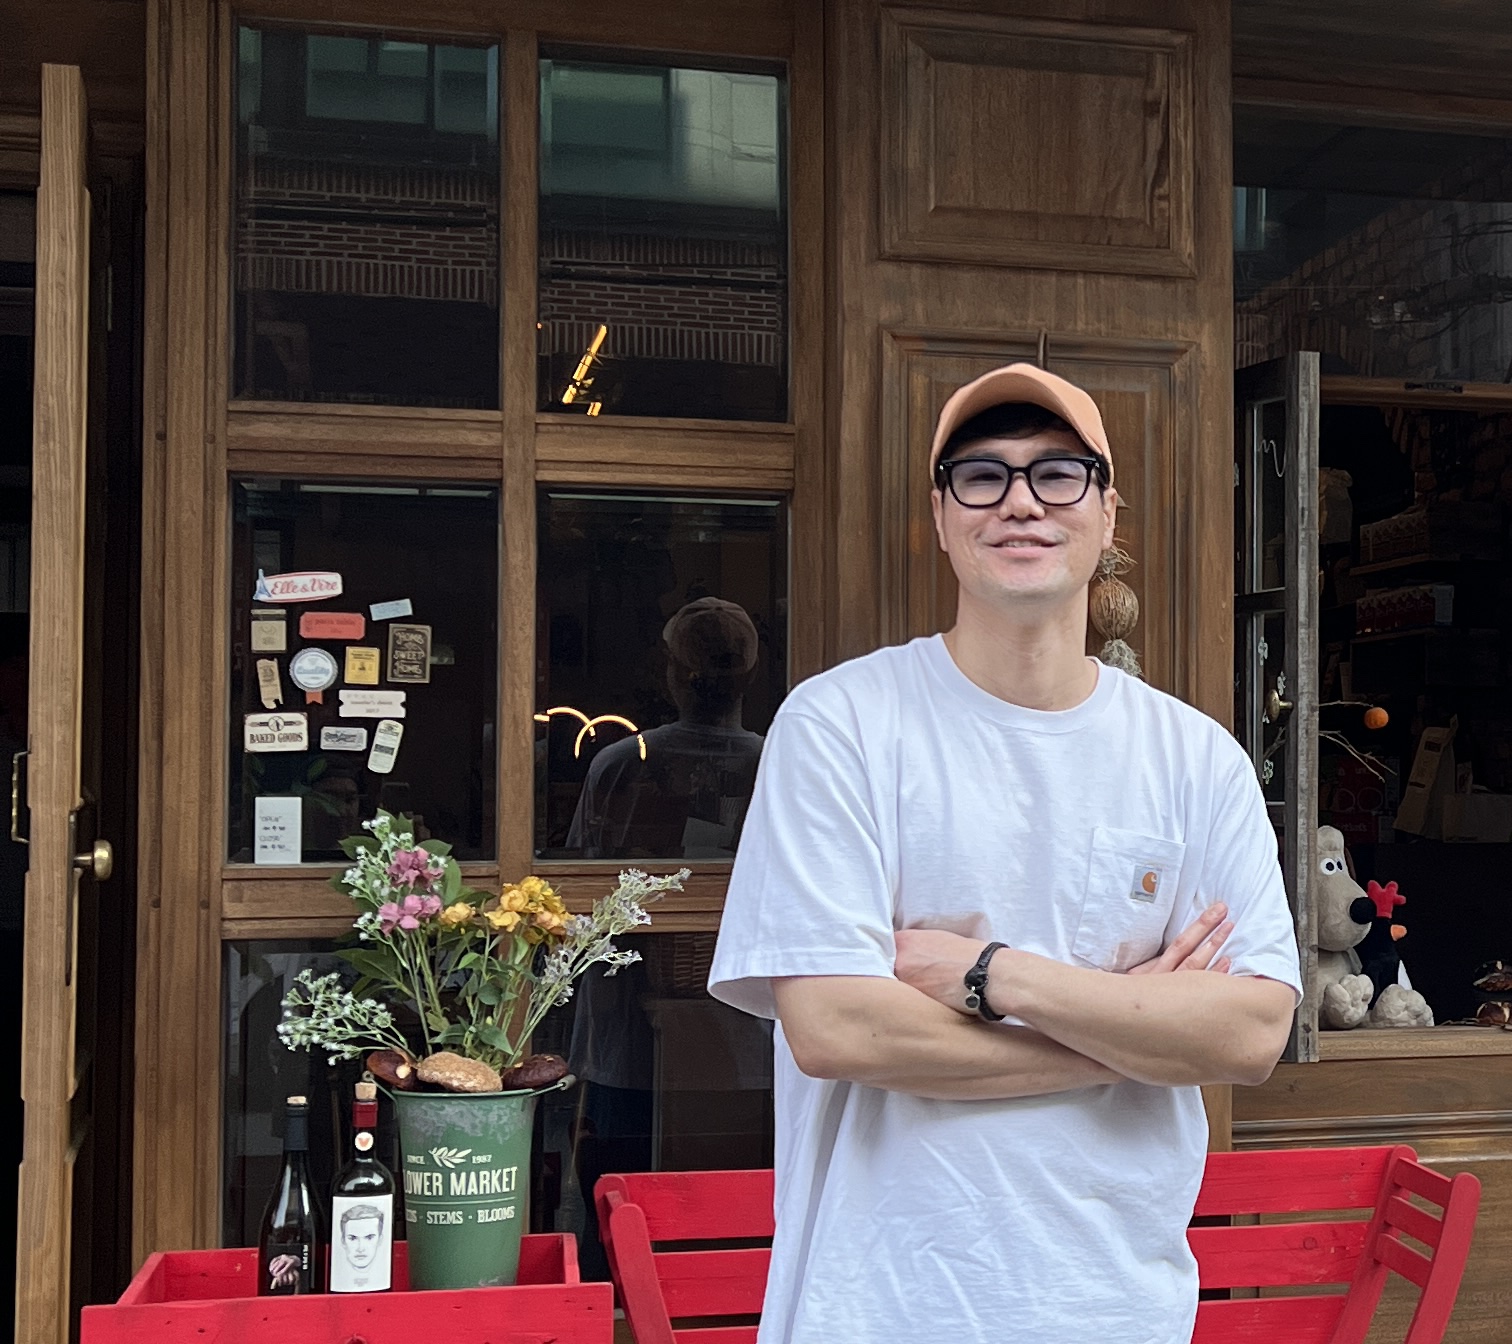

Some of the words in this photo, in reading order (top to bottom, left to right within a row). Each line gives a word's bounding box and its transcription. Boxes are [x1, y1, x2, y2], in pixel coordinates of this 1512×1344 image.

[250, 732, 275, 744] BAKED
[450, 1166, 517, 1196] MARKET
[426, 1210, 463, 1225] STEMS
[477, 1205, 515, 1223] BLOOMS
